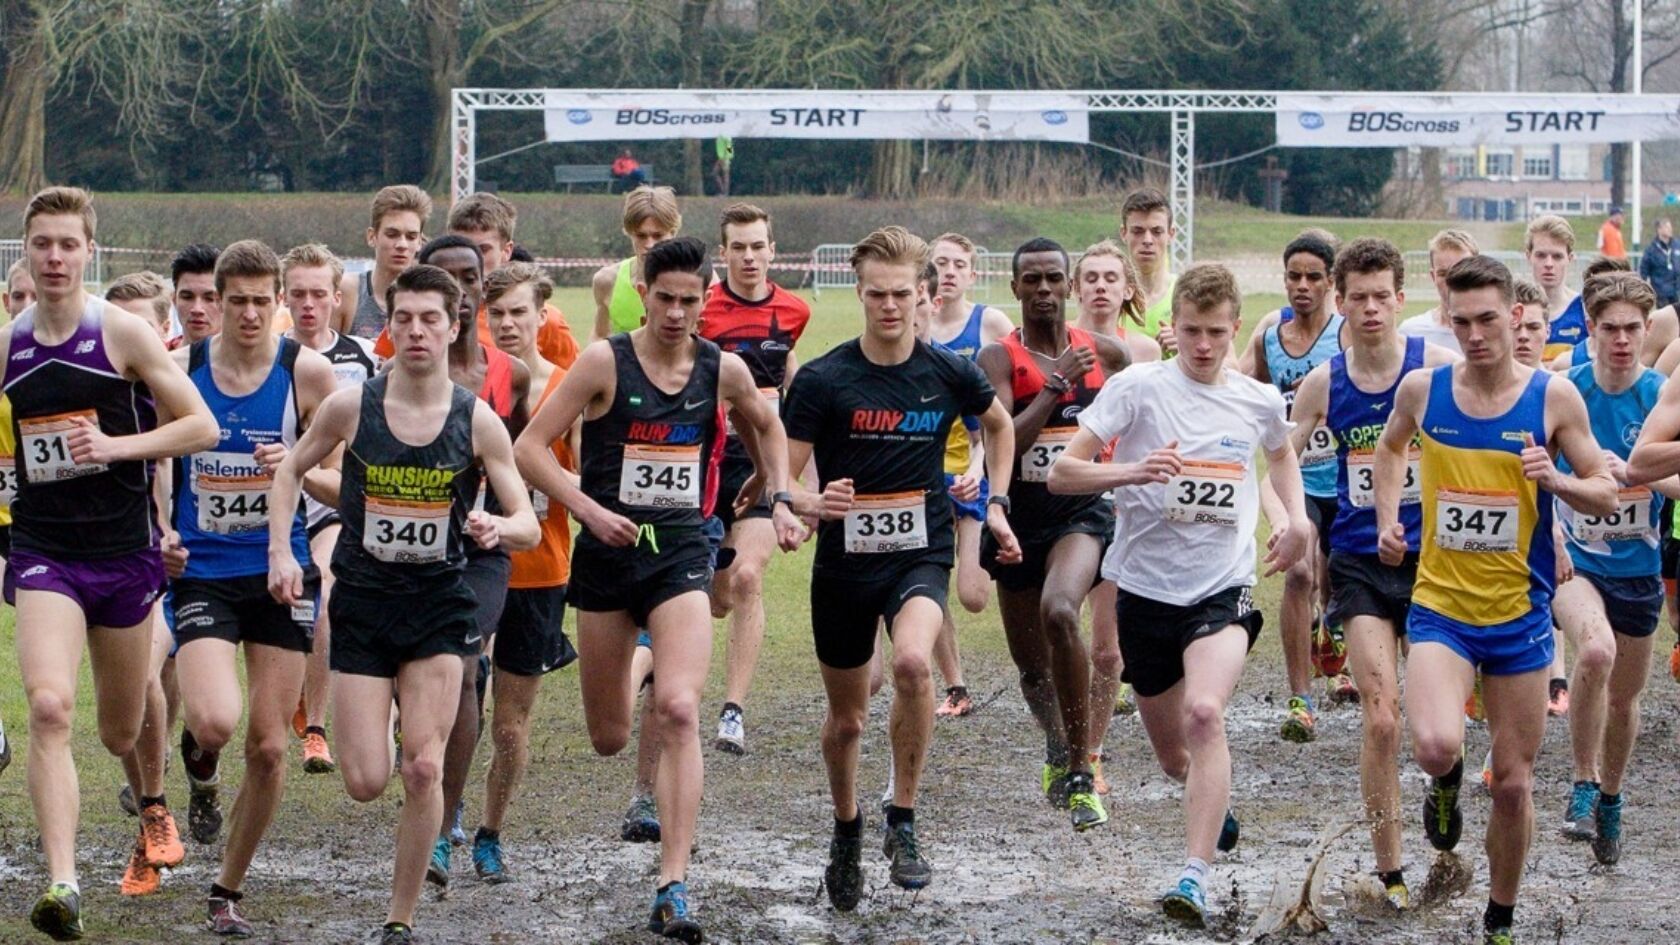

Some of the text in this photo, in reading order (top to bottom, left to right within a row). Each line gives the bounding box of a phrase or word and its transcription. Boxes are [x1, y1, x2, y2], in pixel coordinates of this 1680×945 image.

[614, 108, 866, 126] BOScross START
[1347, 111, 1461, 132] BOScross
[1505, 111, 1605, 132] START
[33, 436, 65, 463] 31
[366, 464, 454, 488] RUNSHOP
[634, 465, 691, 491] 345
[399, 486, 421, 495] VAN
[1177, 480, 1235, 508] 322
[209, 493, 269, 518] 344
[376, 519, 438, 546] 340
[857, 511, 914, 536] 338
[1445, 507, 1508, 536] 347
